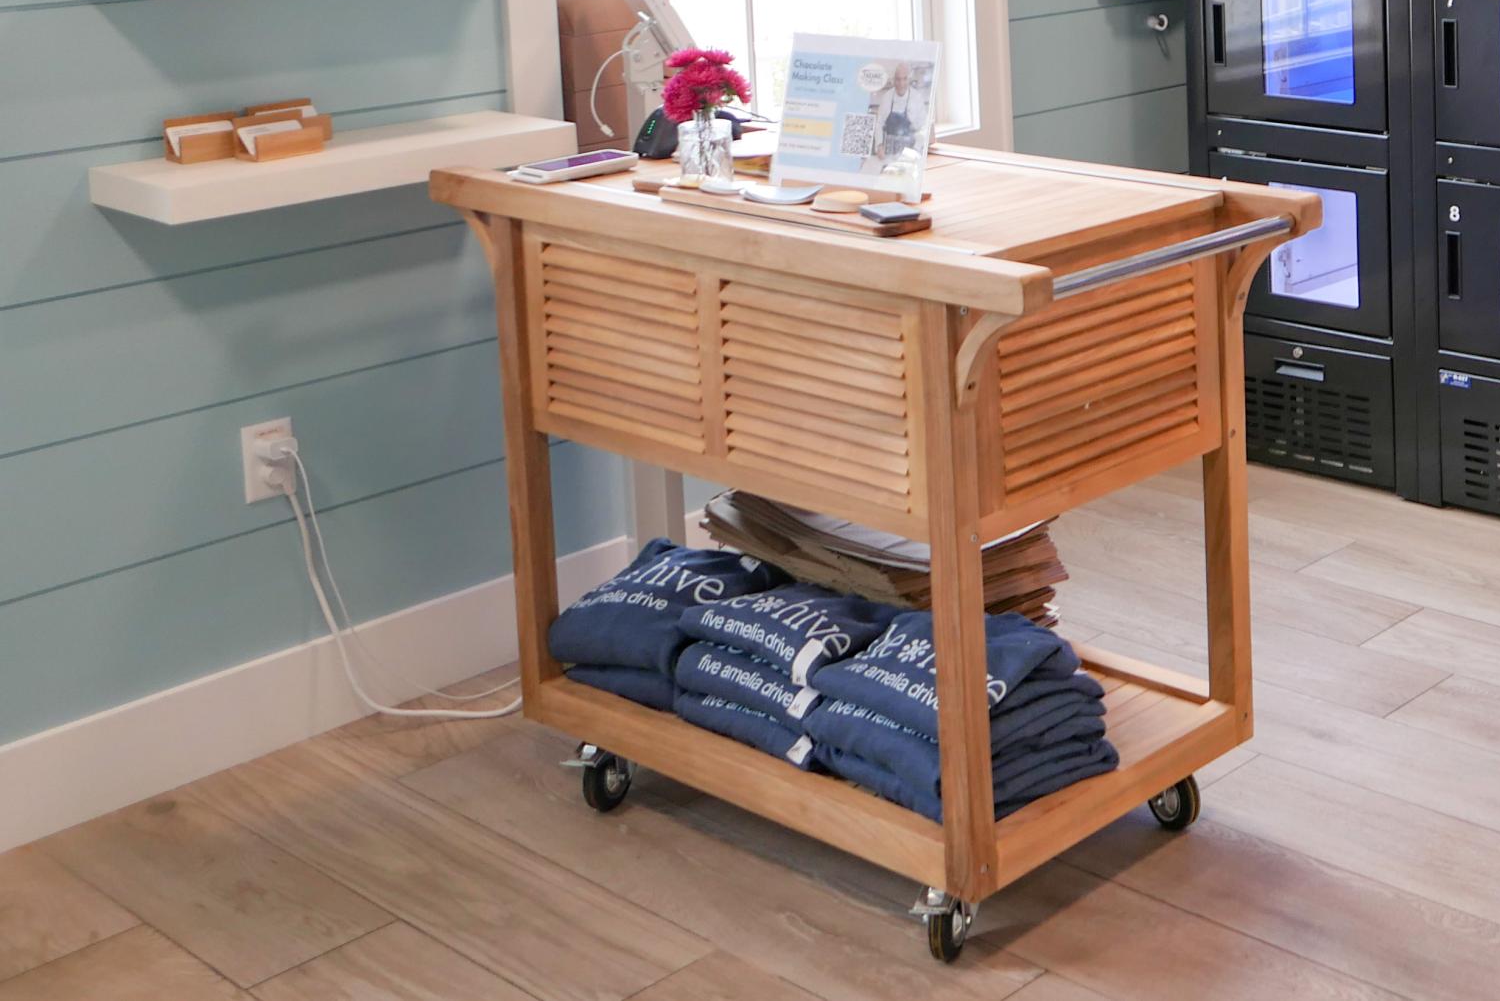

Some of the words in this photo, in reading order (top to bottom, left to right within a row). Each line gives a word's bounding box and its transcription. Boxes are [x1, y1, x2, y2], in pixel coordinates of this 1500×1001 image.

[792, 72, 821, 85] Making
[823, 73, 845, 85] Class
[793, 59, 833, 71] Chocolate
[1449, 205, 1460, 222] 8
[633, 556, 725, 605] hive
[627, 590, 669, 611] drive
[700, 608, 723, 629] five
[723, 616, 765, 644] amelia
[764, 633, 796, 664] drive
[769, 598, 851, 659] hive
[697, 653, 721, 675] five
[720, 664, 761, 691] amelia
[760, 681, 794, 708] drive
[864, 664, 910, 693] amelia
